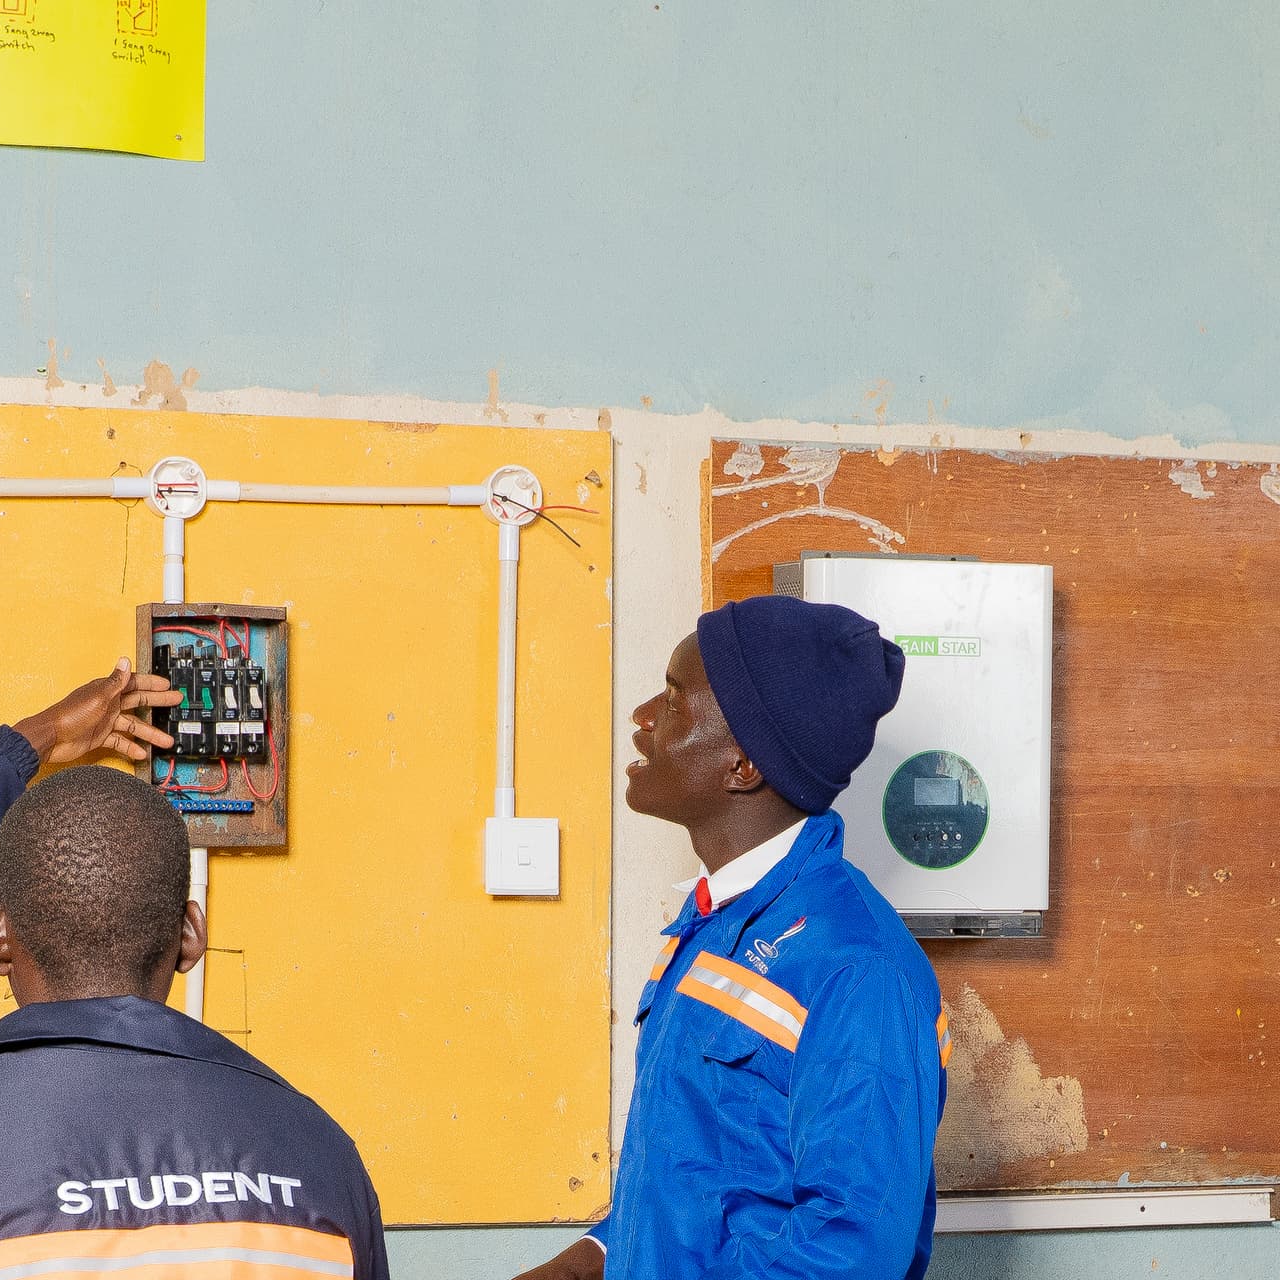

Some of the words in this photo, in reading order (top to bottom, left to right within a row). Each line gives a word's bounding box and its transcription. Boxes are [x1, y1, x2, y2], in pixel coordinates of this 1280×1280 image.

[900, 639, 935, 654] GAIN
[942, 641, 977, 655] STAR
[56, 1171, 302, 1215] STUDENT
